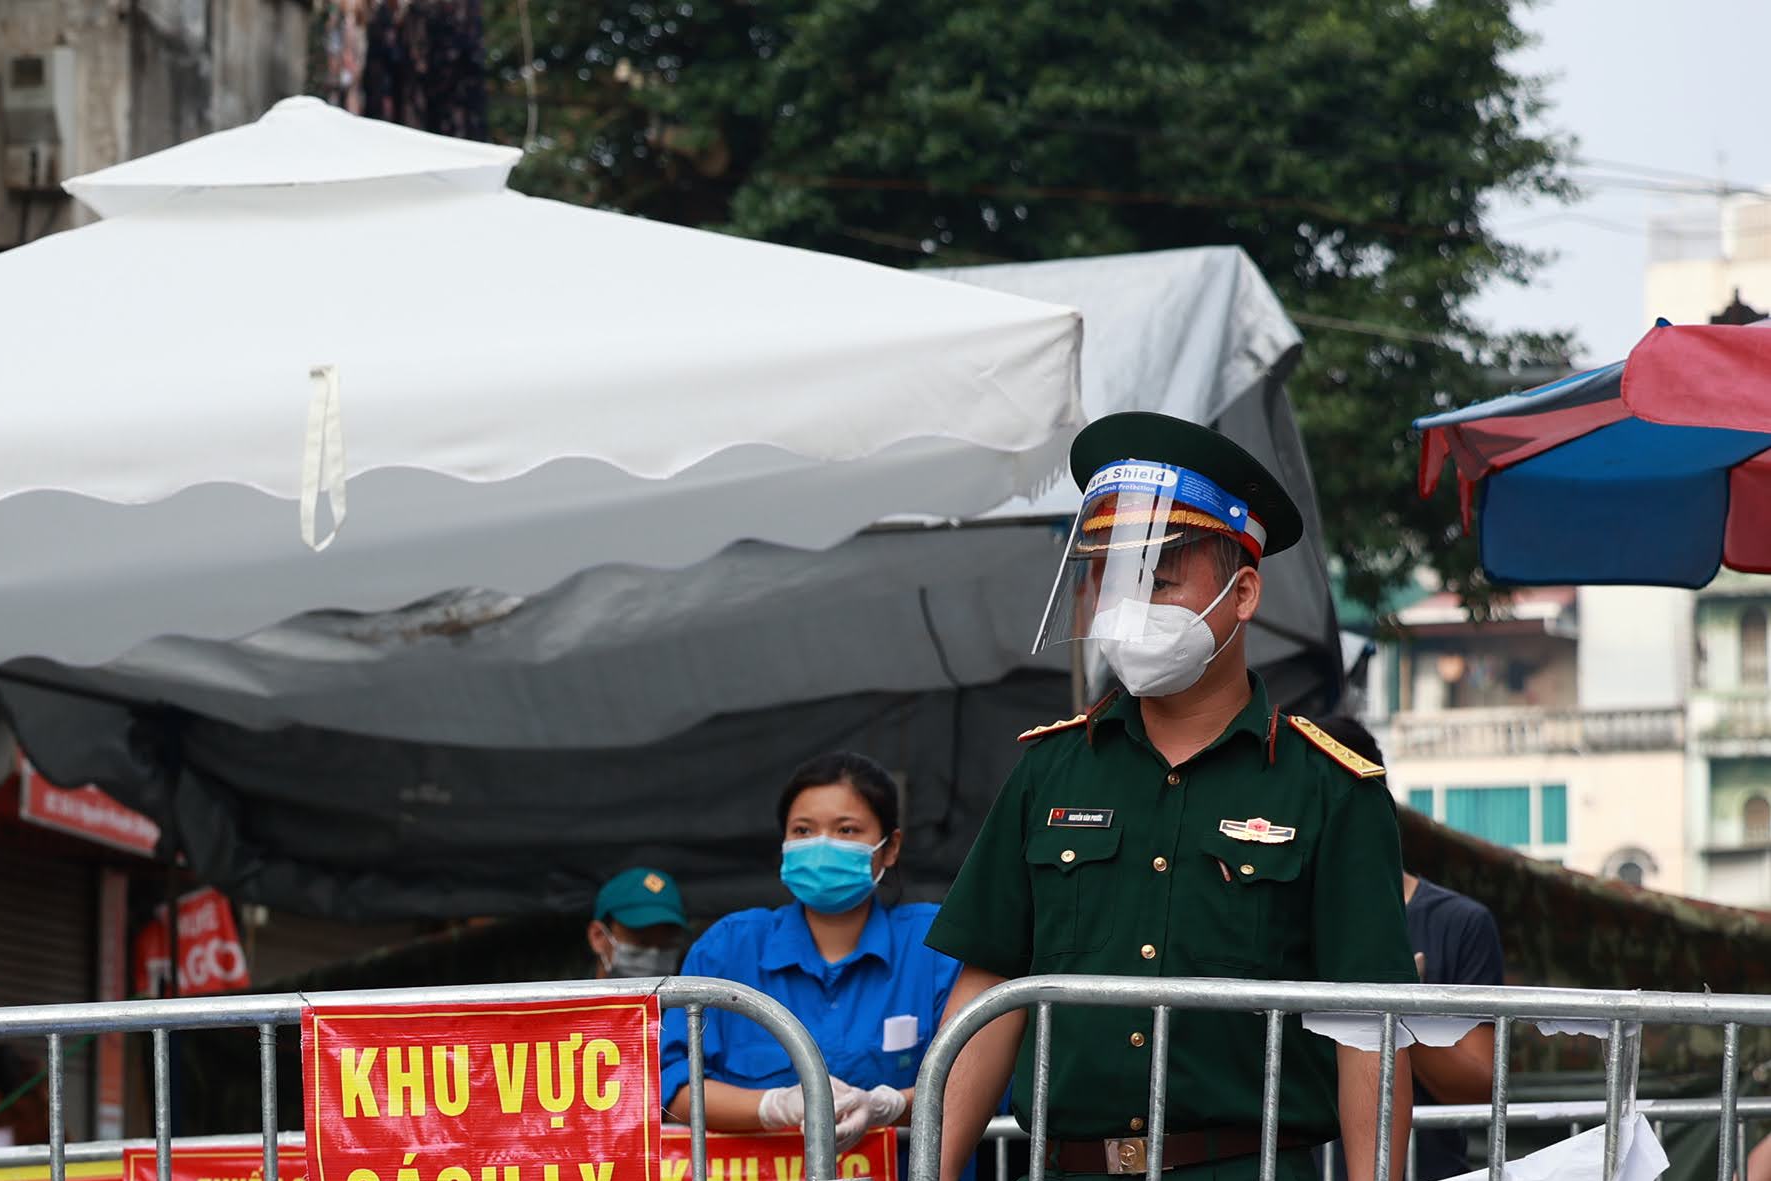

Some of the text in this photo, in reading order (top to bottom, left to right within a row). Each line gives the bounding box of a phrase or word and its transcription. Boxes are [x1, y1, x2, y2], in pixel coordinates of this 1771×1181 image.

[1087, 467, 1166, 489] ace Shield
[340, 1033, 621, 1128] KHU VỰC
